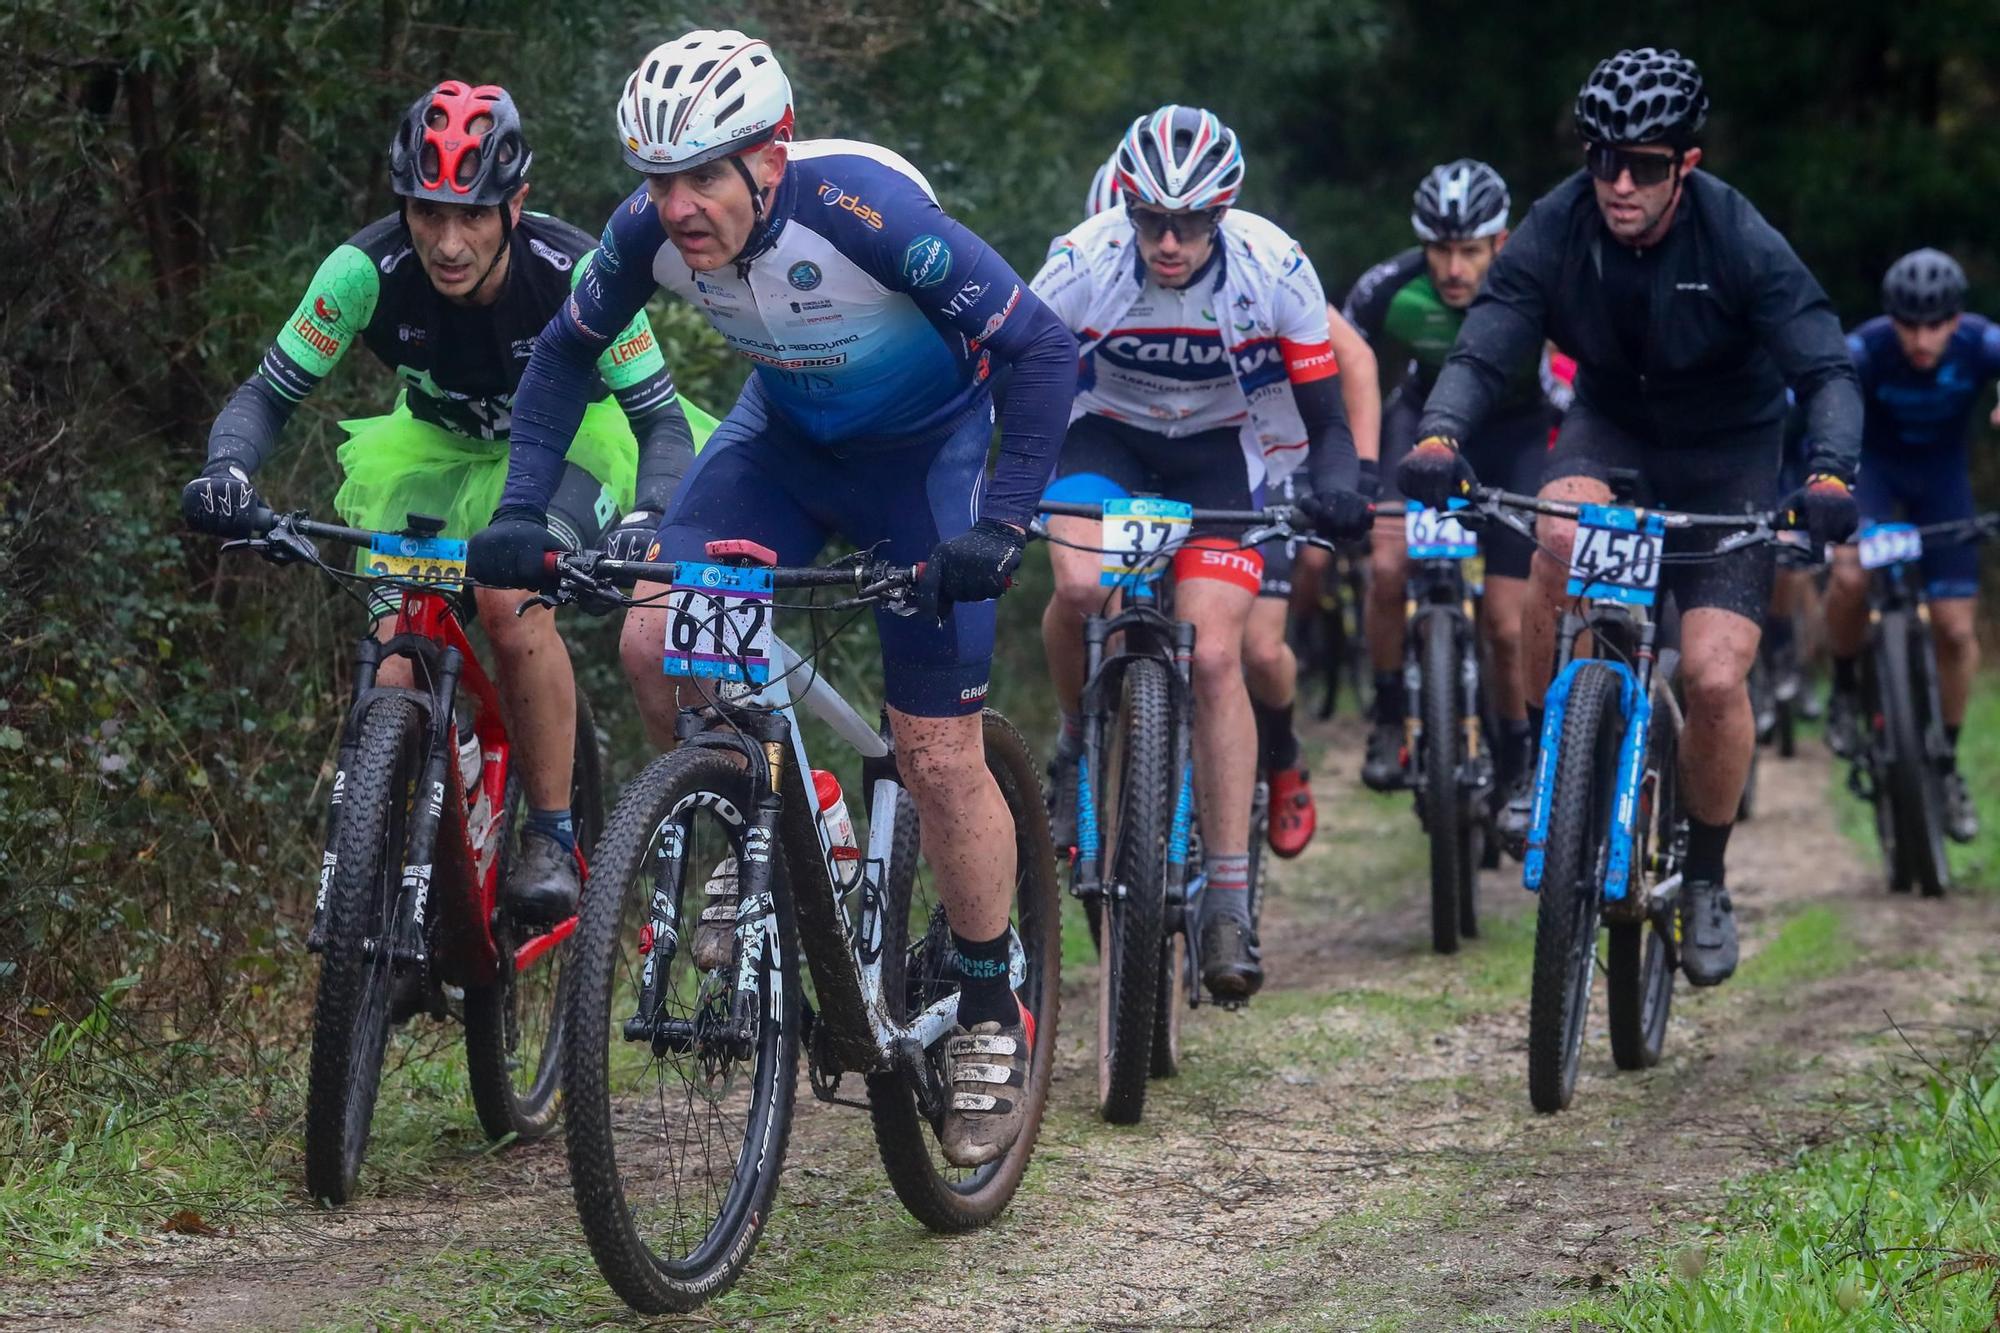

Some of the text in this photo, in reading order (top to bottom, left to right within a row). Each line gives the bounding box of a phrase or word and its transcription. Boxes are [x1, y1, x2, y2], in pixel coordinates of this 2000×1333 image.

[817, 182, 884, 232] rodas
[941, 280, 980, 320] MTS
[293, 313, 341, 357] LEMOS
[1122, 519, 1173, 568] 37
[1575, 527, 1655, 585] 450
[671, 592, 765, 657] 612
[684, 1262, 730, 1294] SAGUARO
